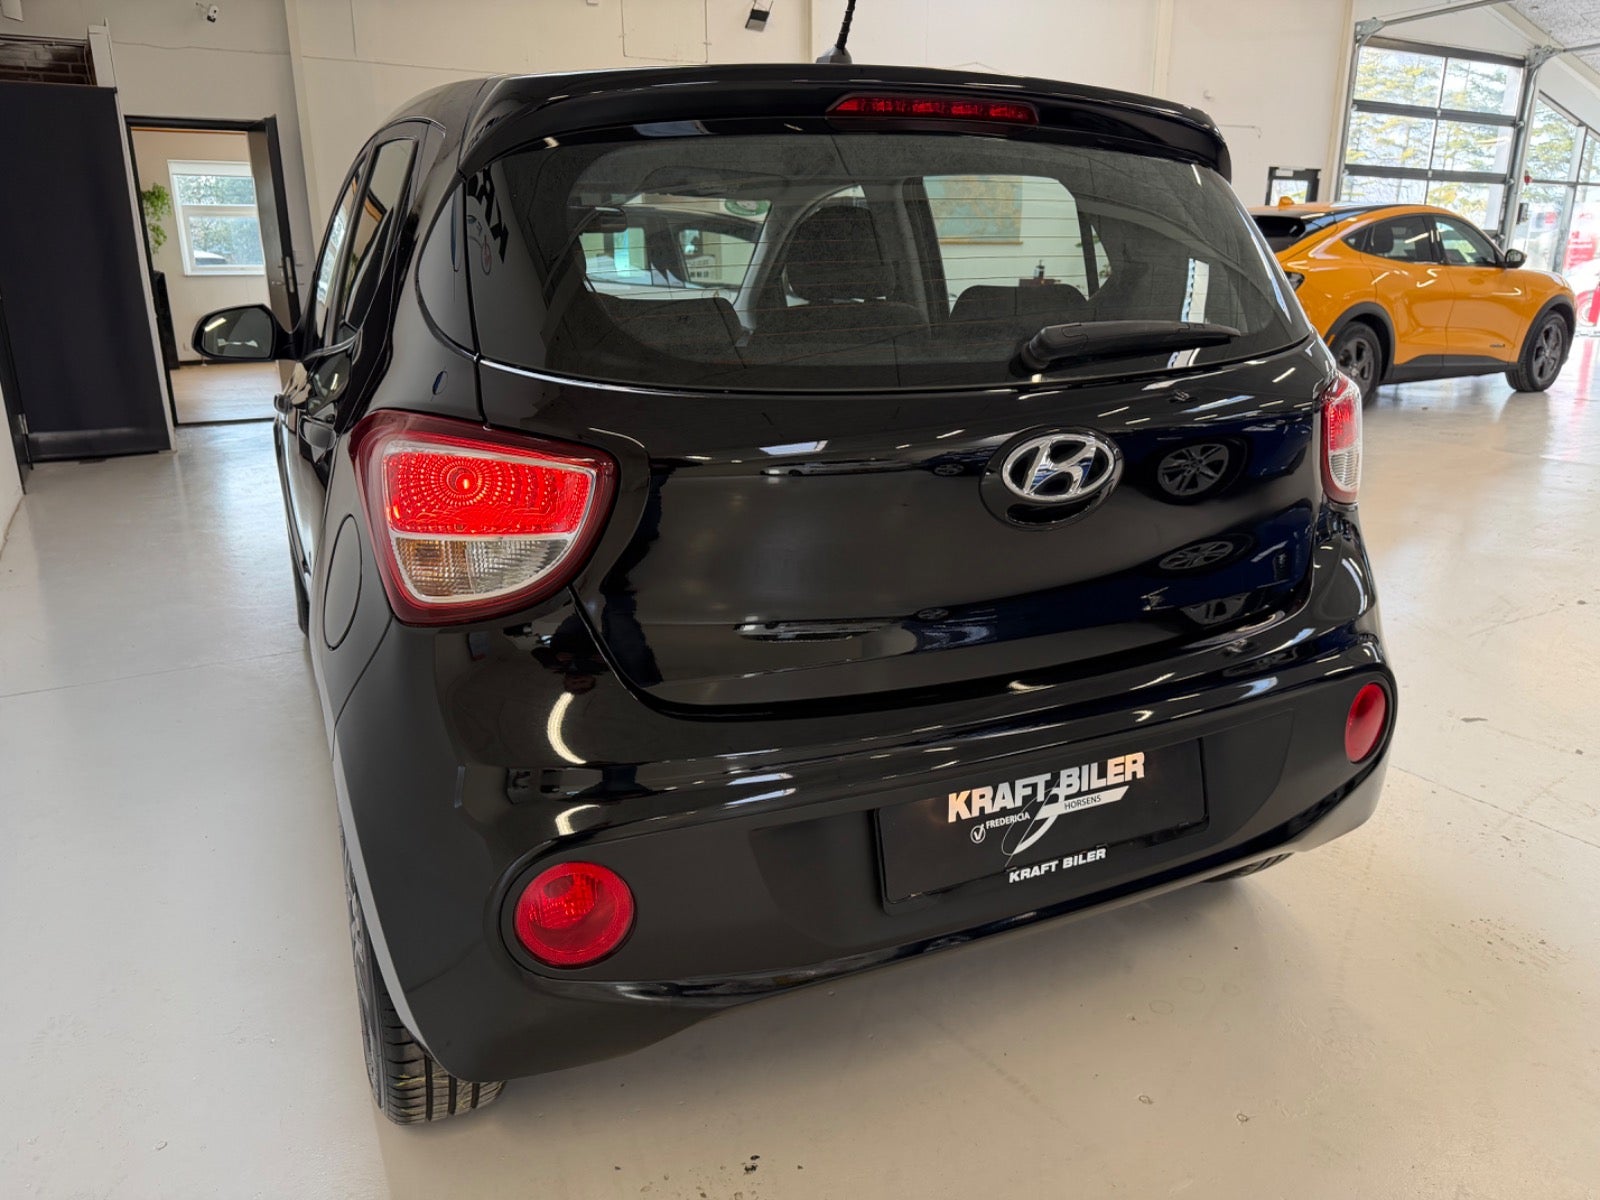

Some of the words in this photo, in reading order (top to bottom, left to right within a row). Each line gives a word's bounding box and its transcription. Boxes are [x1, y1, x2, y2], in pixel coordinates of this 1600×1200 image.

[948, 772, 1052, 824] KRAFT
[1059, 752, 1146, 799] BILER
[1064, 794, 1102, 811] HORSENS
[985, 811, 1031, 830] FREDERICIA
[1009, 860, 1059, 884] KRAFT
[1062, 847, 1107, 869] BILER
